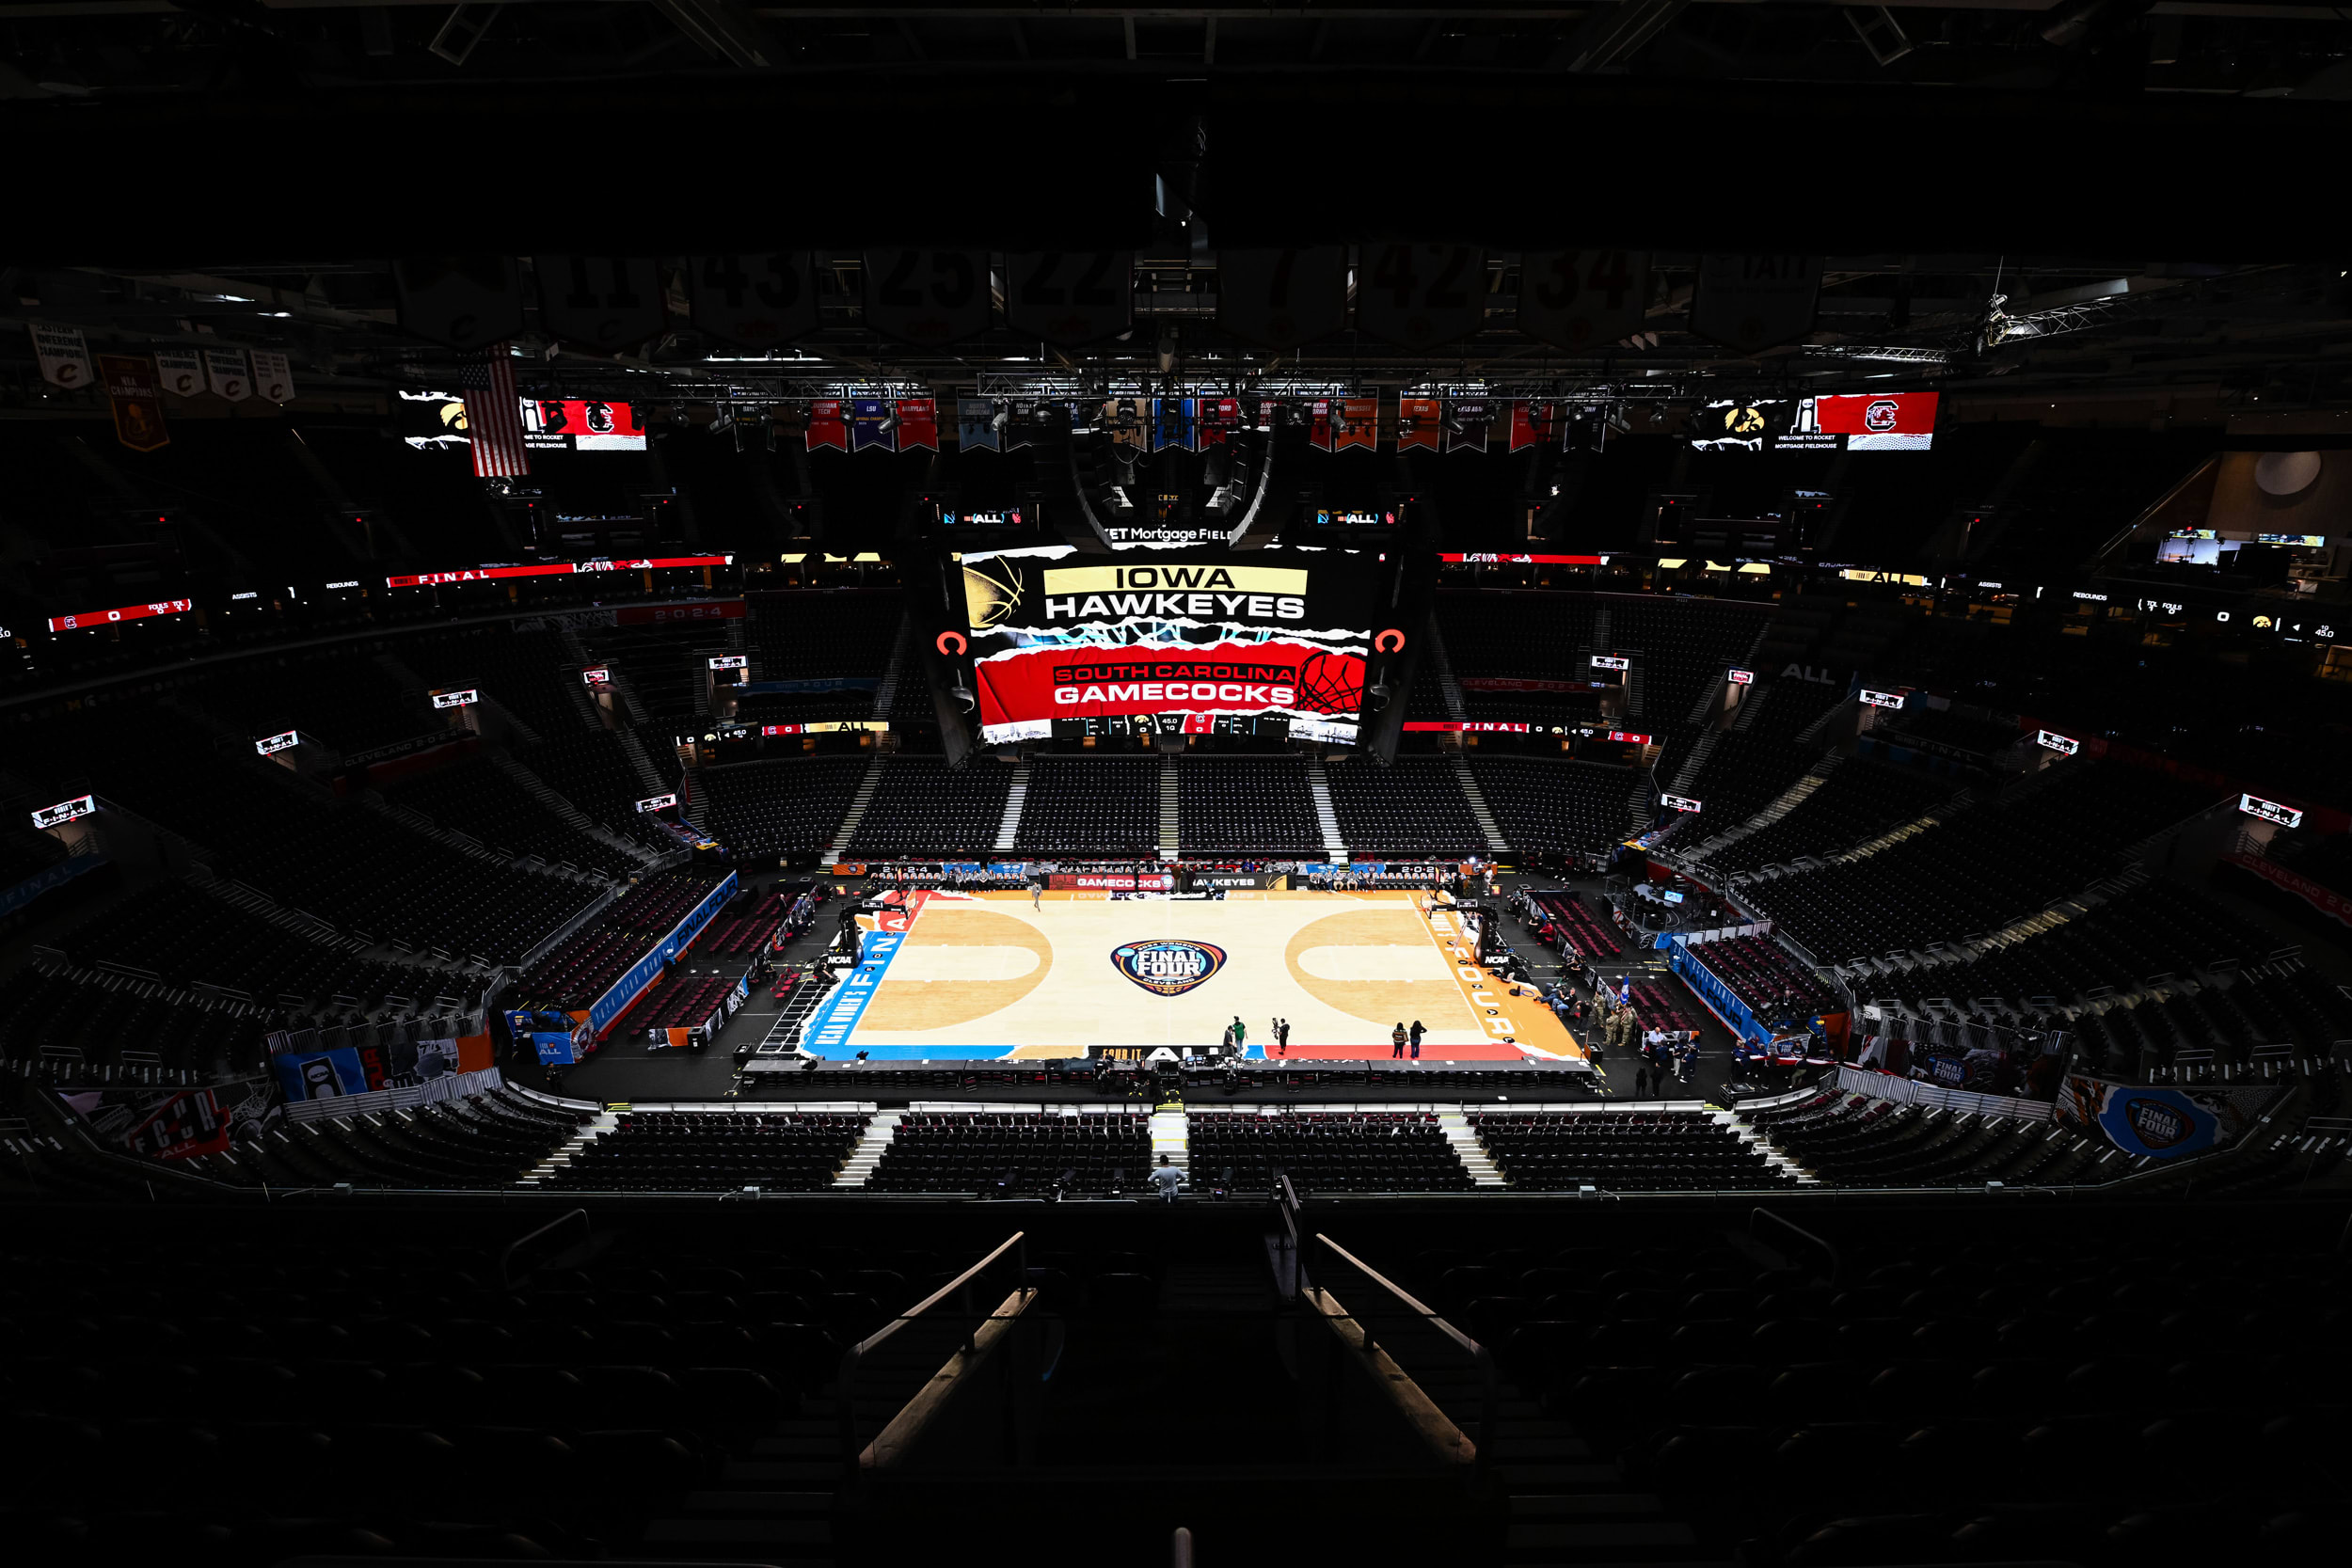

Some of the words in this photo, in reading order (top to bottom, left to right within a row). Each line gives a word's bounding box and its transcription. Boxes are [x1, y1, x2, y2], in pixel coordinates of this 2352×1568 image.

[1131, 528, 1198, 543] Mortgage
[1116, 567, 1236, 589] IOWA
[326, 580, 359, 589] REBOUNDS
[1978, 580, 2002, 589] ASSISTS
[231, 592, 258, 600] ASSISTS
[2073, 591, 2107, 601] REBOUNDS
[148, 602, 168, 610] FOULS
[1045, 593, 1306, 620] HAWKEYES
[2162, 602, 2183, 610] FOULS
[2314, 628, 2334, 638] 45.0
[1054, 665, 1149, 682] SOUTH
[1152, 663, 1295, 682] CAROLINA
[1780, 662, 1836, 687] ALL
[1462, 679, 1523, 689] CLEVELAND
[1053, 683, 1295, 705] GAMECOCKS
[837, 721, 870, 732] ALL
[1462, 722, 1523, 733] FINAL
[2242, 853, 2321, 898] CLEVELAND
[827, 956, 852, 964] NCAA
[1137, 951, 1200, 962] FINAL
[1485, 956, 1509, 964] NCAA
[1136, 961, 1201, 976] FOUR
[1936, 1059, 1965, 1077] FINAL
[1933, 1068, 1963, 1085] FOUR
[2139, 1105, 2180, 1128] FINAL
[2136, 1117, 2178, 1140] FOUR
